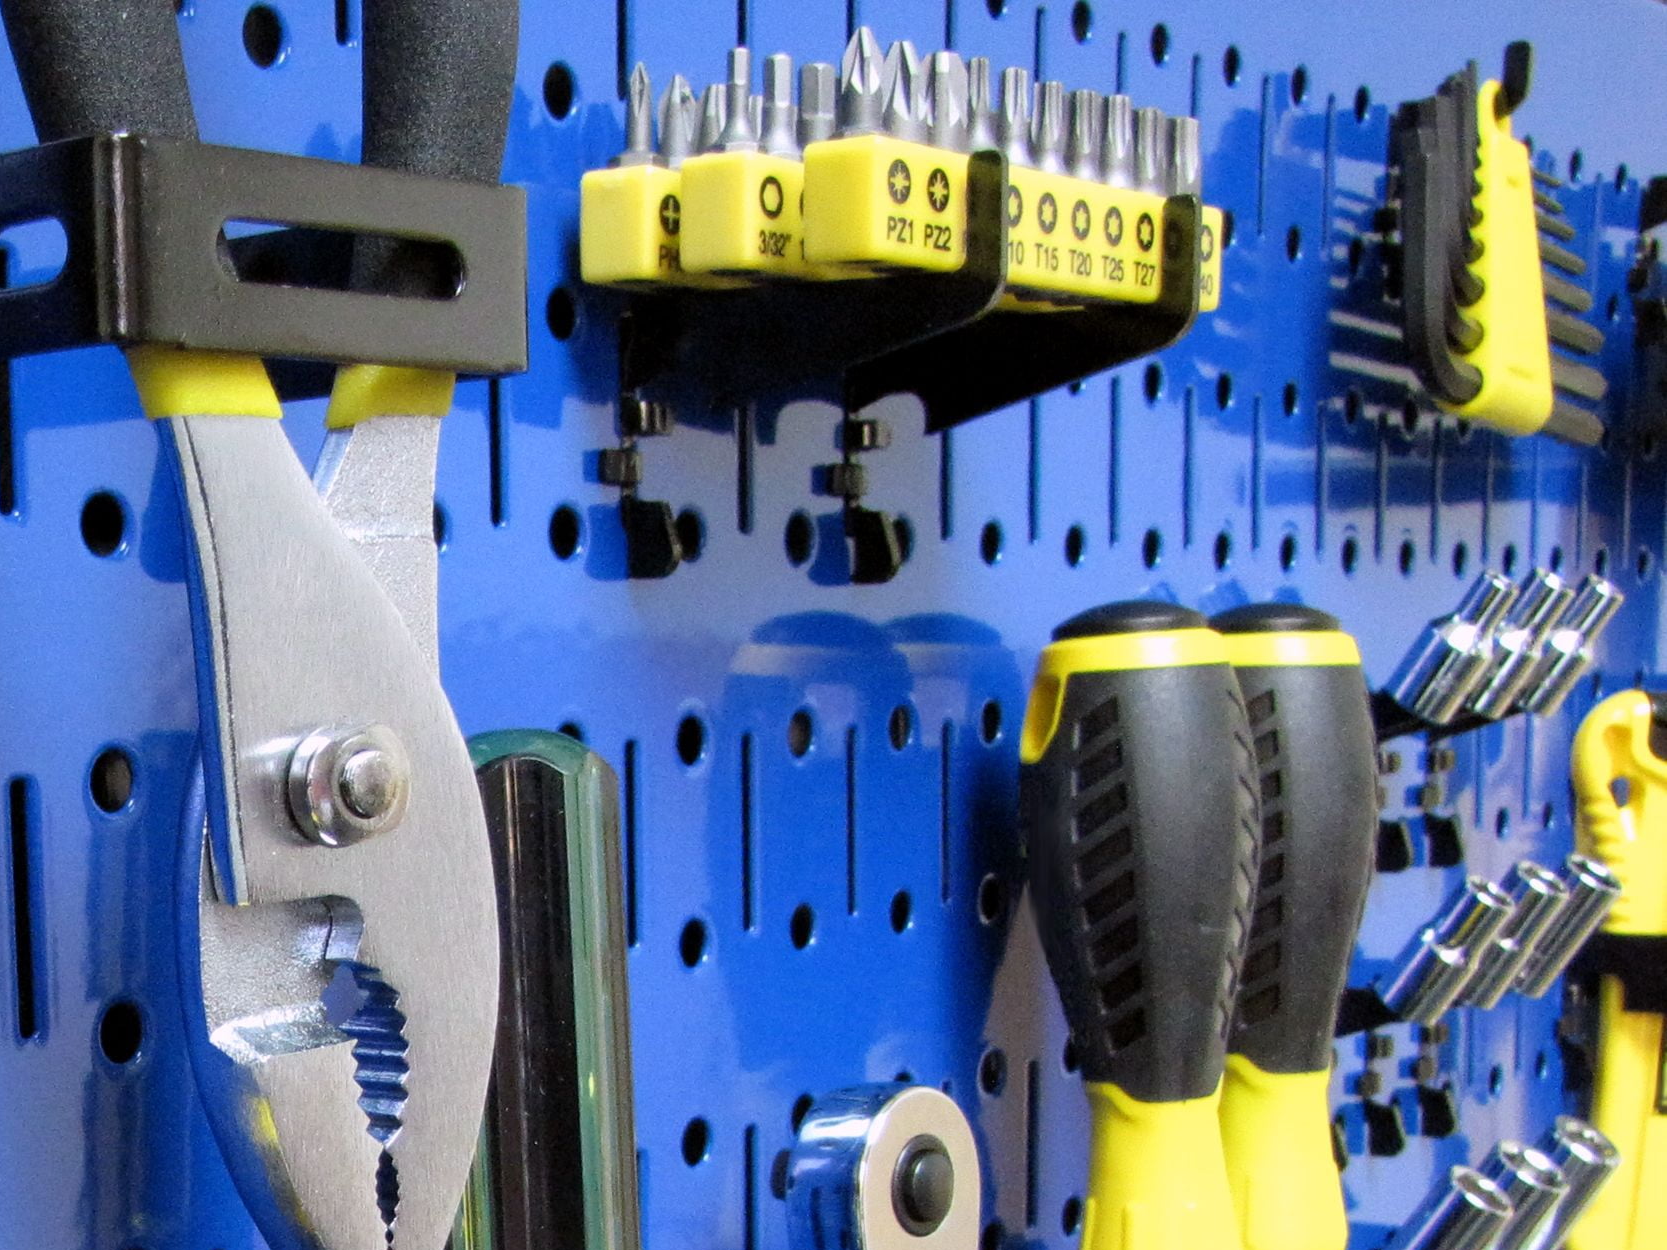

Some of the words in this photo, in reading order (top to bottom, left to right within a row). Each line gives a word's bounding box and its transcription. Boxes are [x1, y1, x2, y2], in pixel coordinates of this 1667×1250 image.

[887, 215, 914, 244] PZ1
[924, 223, 952, 252] PZ2
[1008, 240, 1025, 265] 10
[1034, 243, 1059, 272] T15
[1068, 249, 1092, 277] T20
[1101, 255, 1125, 282] T25
[1133, 260, 1157, 287] T27
